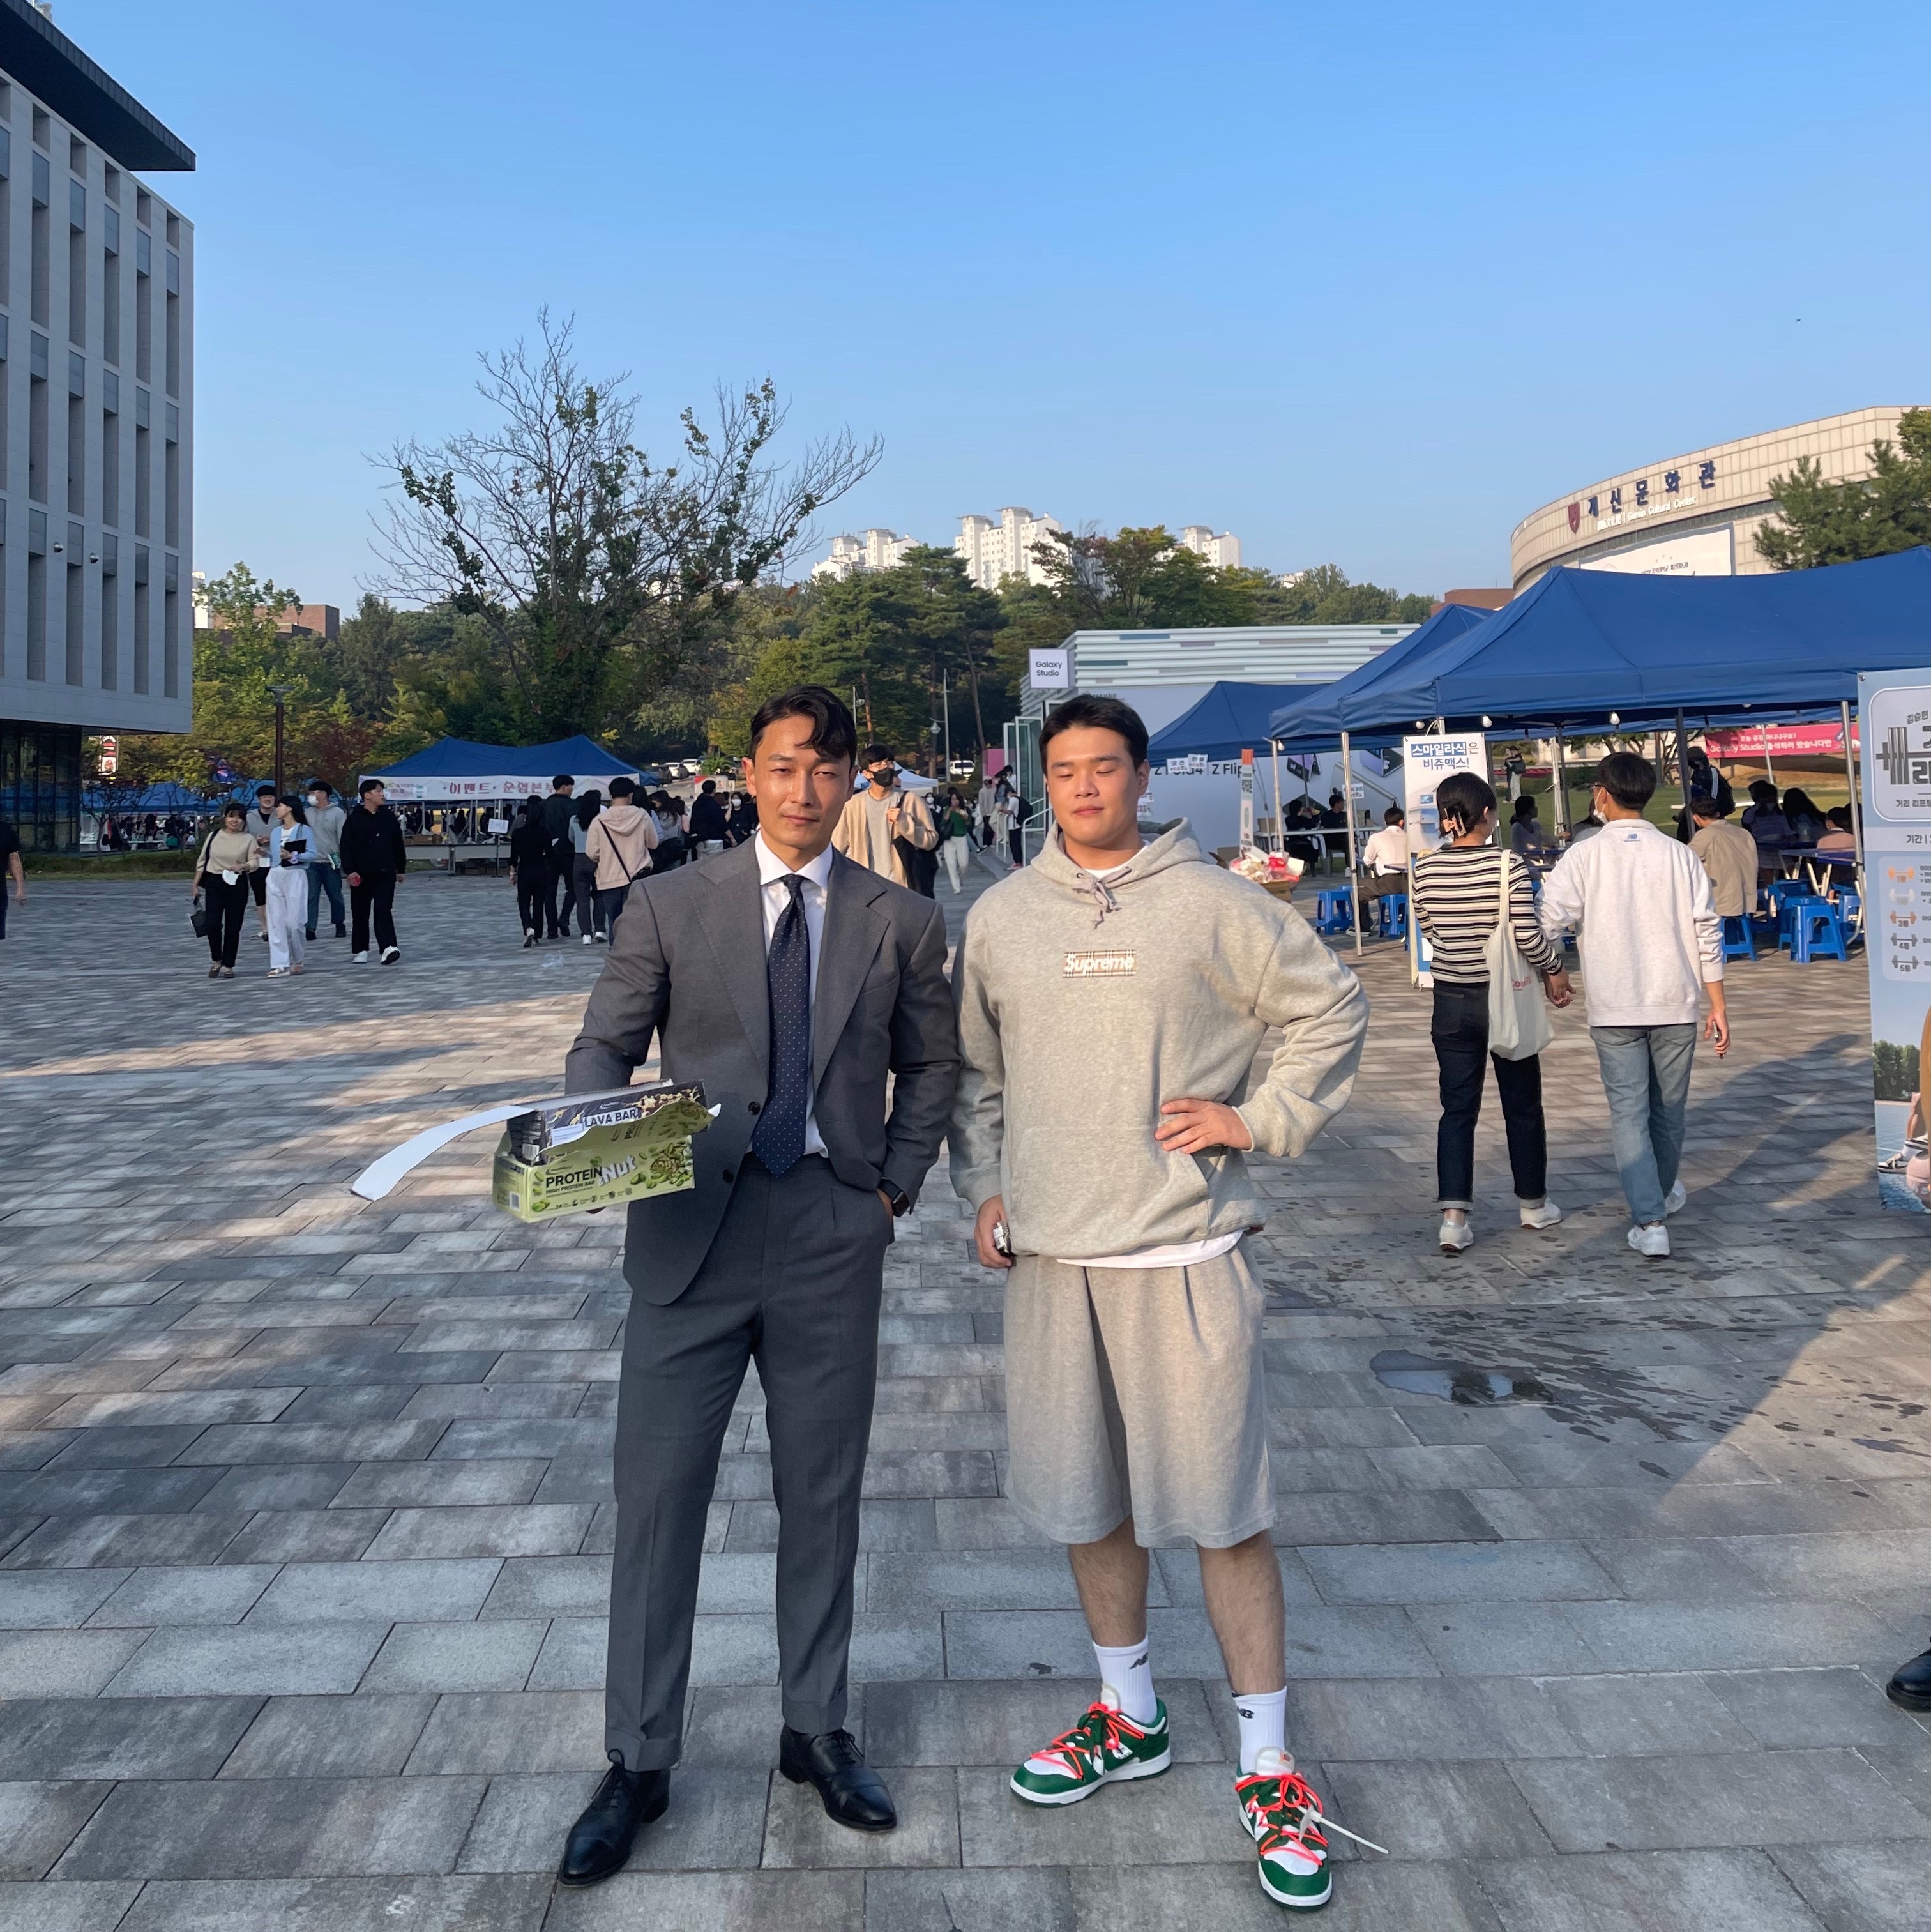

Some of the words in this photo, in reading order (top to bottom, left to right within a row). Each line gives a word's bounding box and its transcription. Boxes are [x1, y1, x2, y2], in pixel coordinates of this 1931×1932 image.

[1648, 501, 1671, 515] Cultural
[1674, 496, 1696, 509] Center
[1036, 661, 1063, 669] Galaxy
[1907, 710, 1928, 724] 김승현
[1212, 764, 1220, 775] Z
[1423, 757, 1469, 770] 비쥬맥스!
[1907, 835, 1922, 843] 기간
[1064, 954, 1135, 975] Supreme
[584, 1114, 612, 1127] LAVA
[615, 1109, 638, 1122] BAR
[546, 1166, 602, 1188] PROTEIN
